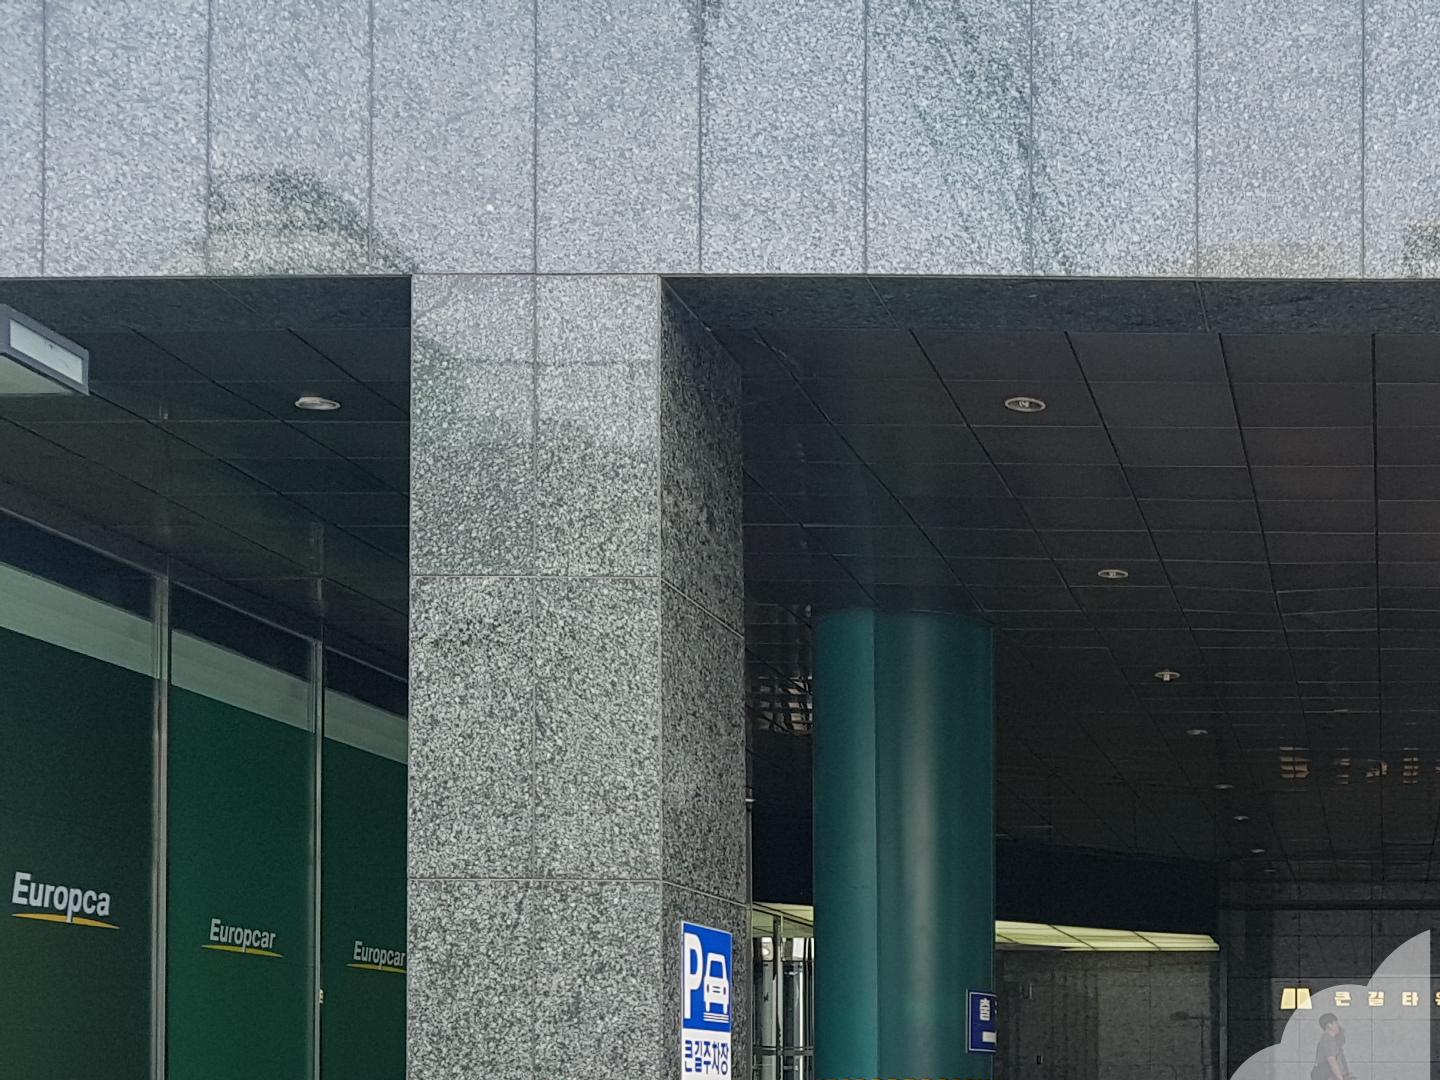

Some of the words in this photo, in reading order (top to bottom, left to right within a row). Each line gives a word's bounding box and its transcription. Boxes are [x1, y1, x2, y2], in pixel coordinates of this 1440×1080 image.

[11, 871, 111, 923] Europca
[209, 918, 276, 953] Europcar
[352, 940, 406, 971] Europcar
[684, 932, 703, 1019] P
[684, 1039, 729, 1076] 큰길주차장
